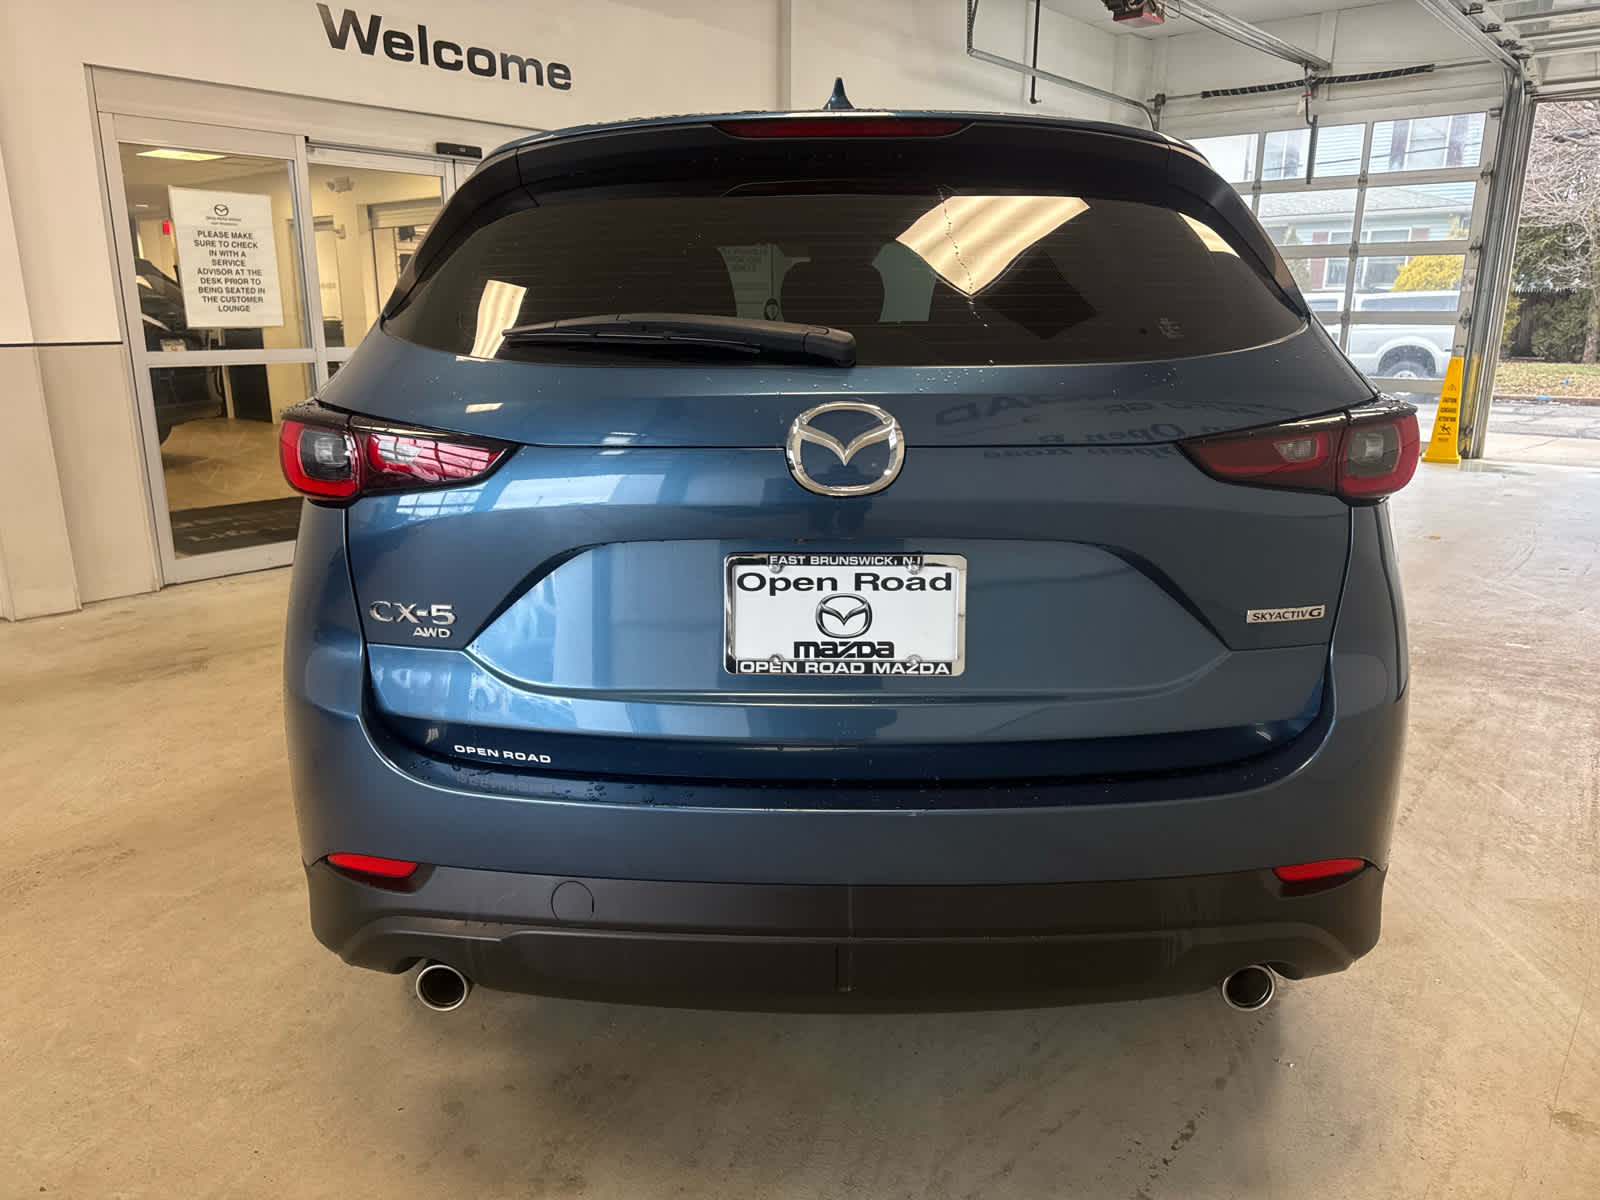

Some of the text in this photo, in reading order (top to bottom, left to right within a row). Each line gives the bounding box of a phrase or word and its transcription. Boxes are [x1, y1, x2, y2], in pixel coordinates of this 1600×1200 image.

[316, 2, 572, 91] Welcome
[197, 230, 253, 240] PLEASE MAKE
[194, 239, 216, 247] SURE
[231, 241, 258, 249] CHECK
[209, 249, 247, 258] IN WITH A
[212, 259, 246, 267] SERVICE
[197, 268, 233, 276] ADVISOR
[200, 277, 223, 285] DESK
[250, 278, 261, 286] TO
[198, 286, 223, 294] BEING
[257, 287, 266, 295] IN
[202, 295, 219, 303] THE
[218, 305, 251, 313] LOUNGE
[769, 555, 806, 565] EAST
[810, 556, 898, 566] BRUNSWICK,
[736, 572, 952, 597] Open Road
[369, 600, 456, 625] CX-5
[412, 626, 451, 638] AWD
[739, 661, 951, 675] OPEN ROAD MAZDA
[454, 744, 552, 764] OPEN ROAD
